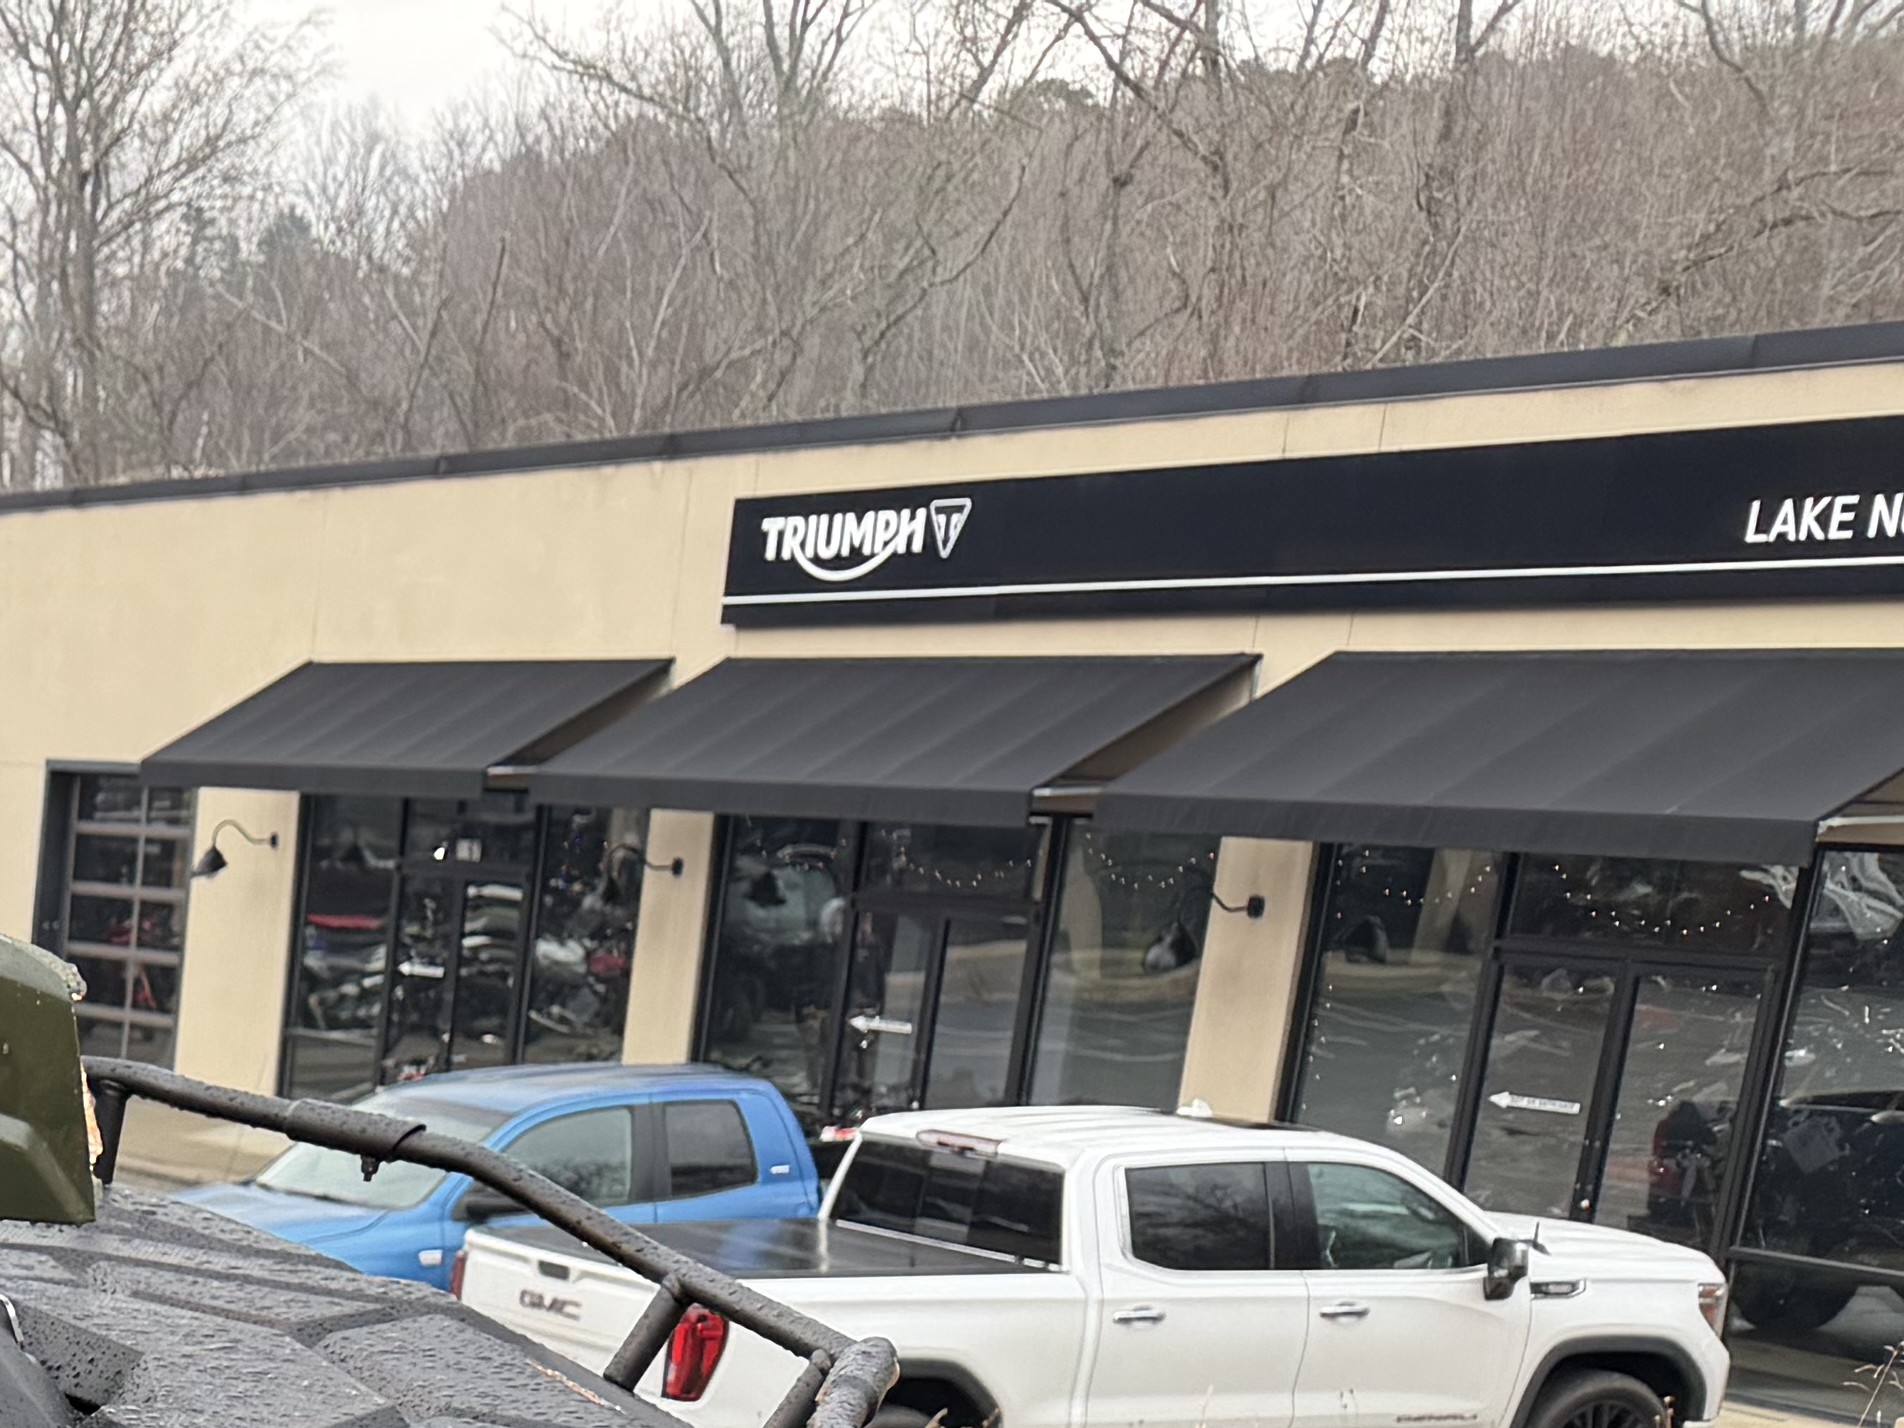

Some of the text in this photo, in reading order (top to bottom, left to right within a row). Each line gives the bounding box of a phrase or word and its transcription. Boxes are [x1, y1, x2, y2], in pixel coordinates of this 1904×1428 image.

[1744, 494, 1860, 543] LAKE
[761, 507, 927, 581] TRIUMPH
[519, 1289, 582, 1321] GMC
